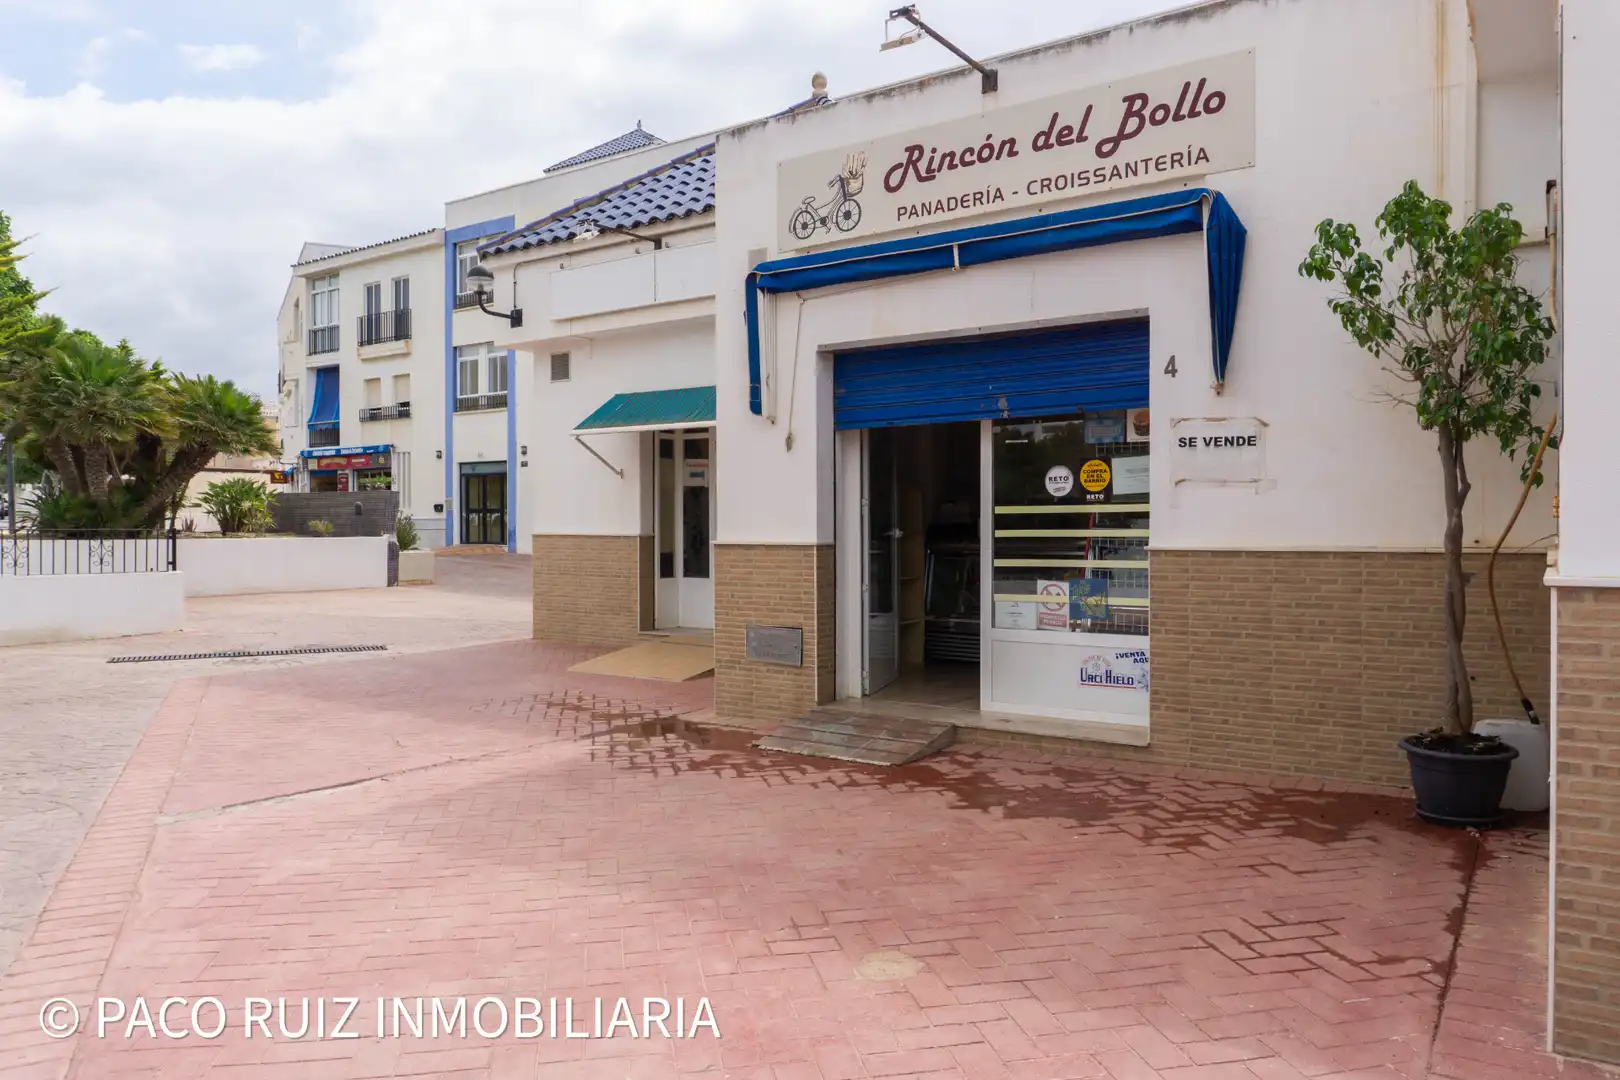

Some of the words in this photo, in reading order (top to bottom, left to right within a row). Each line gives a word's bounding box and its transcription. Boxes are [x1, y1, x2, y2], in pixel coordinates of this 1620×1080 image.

[883, 133, 1019, 193] Rincón
[1032, 104, 1093, 152] del
[1095, 77, 1226, 159] Bollo
[897, 185, 1005, 221] PANADERÍA
[1026, 145, 1210, 196] CROISSANTERÍA
[1164, 355, 1178, 378] 4
[1178, 437, 1198, 448] SE
[1202, 435, 1257, 448] VENDE
